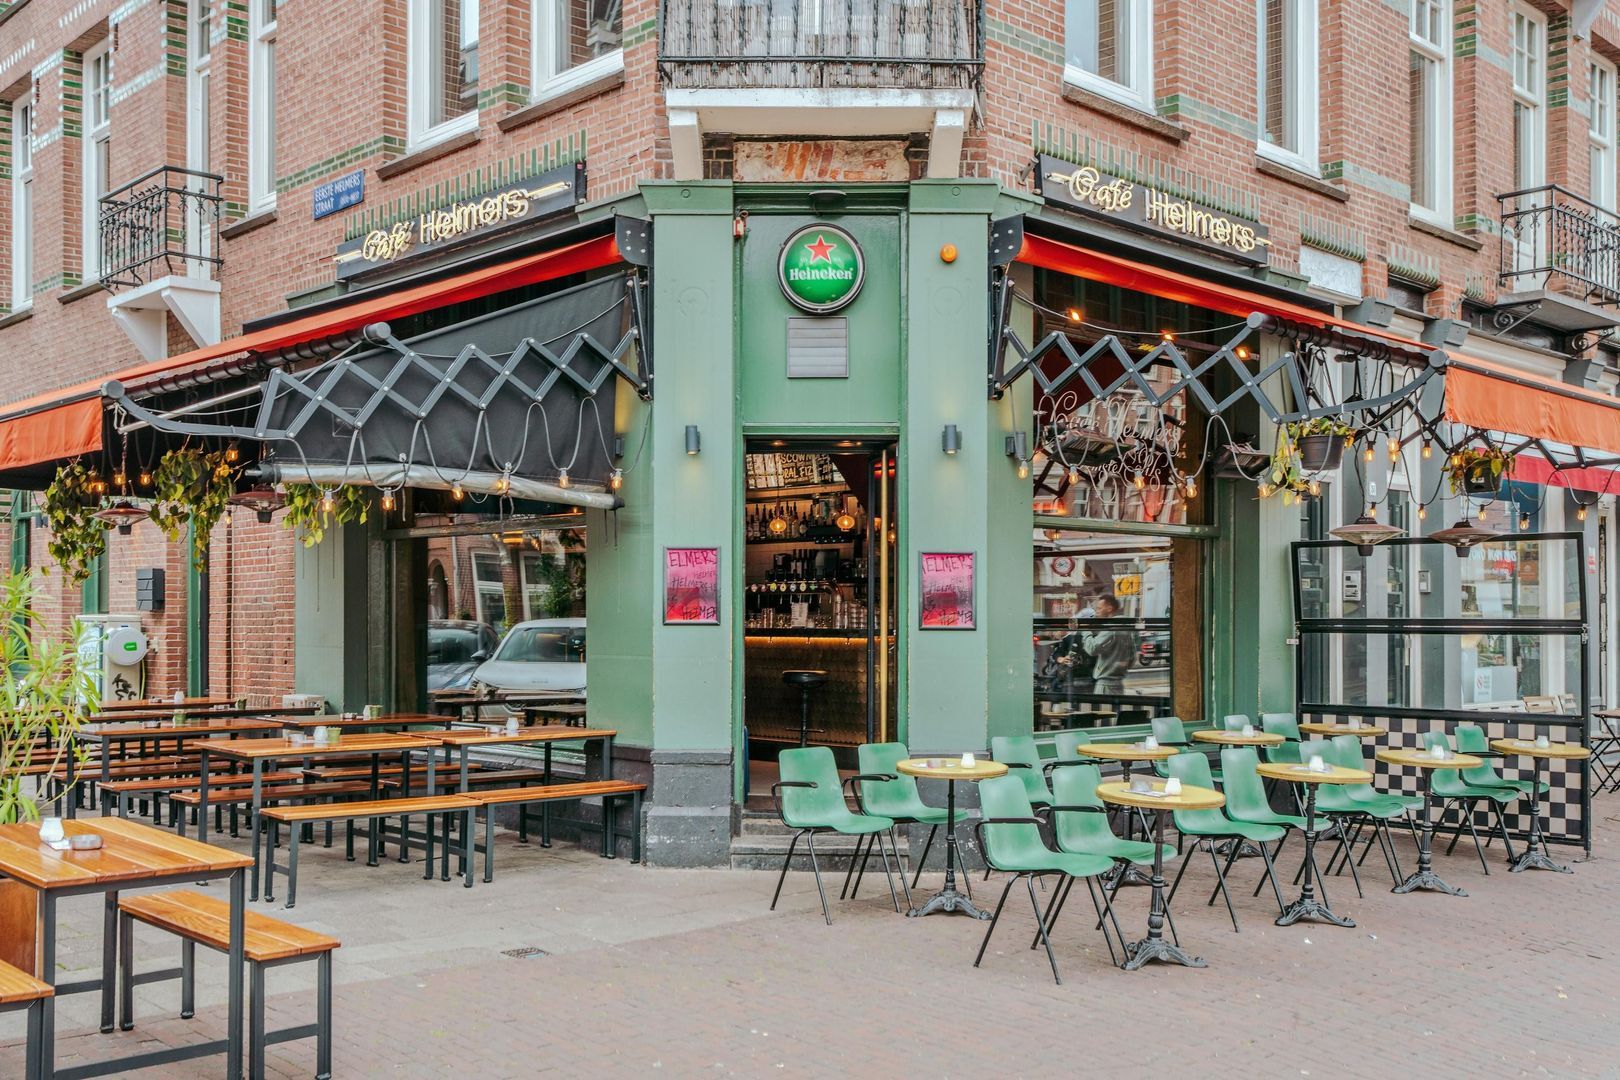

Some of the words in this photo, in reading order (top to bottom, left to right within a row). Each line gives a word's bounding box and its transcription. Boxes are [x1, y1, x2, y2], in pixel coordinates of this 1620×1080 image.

[315, 183, 334, 202] EERSTE
[334, 173, 361, 193] HELMERS
[314, 197, 335, 216] STRAAT
[1069, 167, 1133, 212] Café
[1146, 188, 1256, 252] Helmers
[361, 221, 413, 261] Café
[420, 188, 530, 245] Helmers
[789, 267, 853, 282] Heineken
